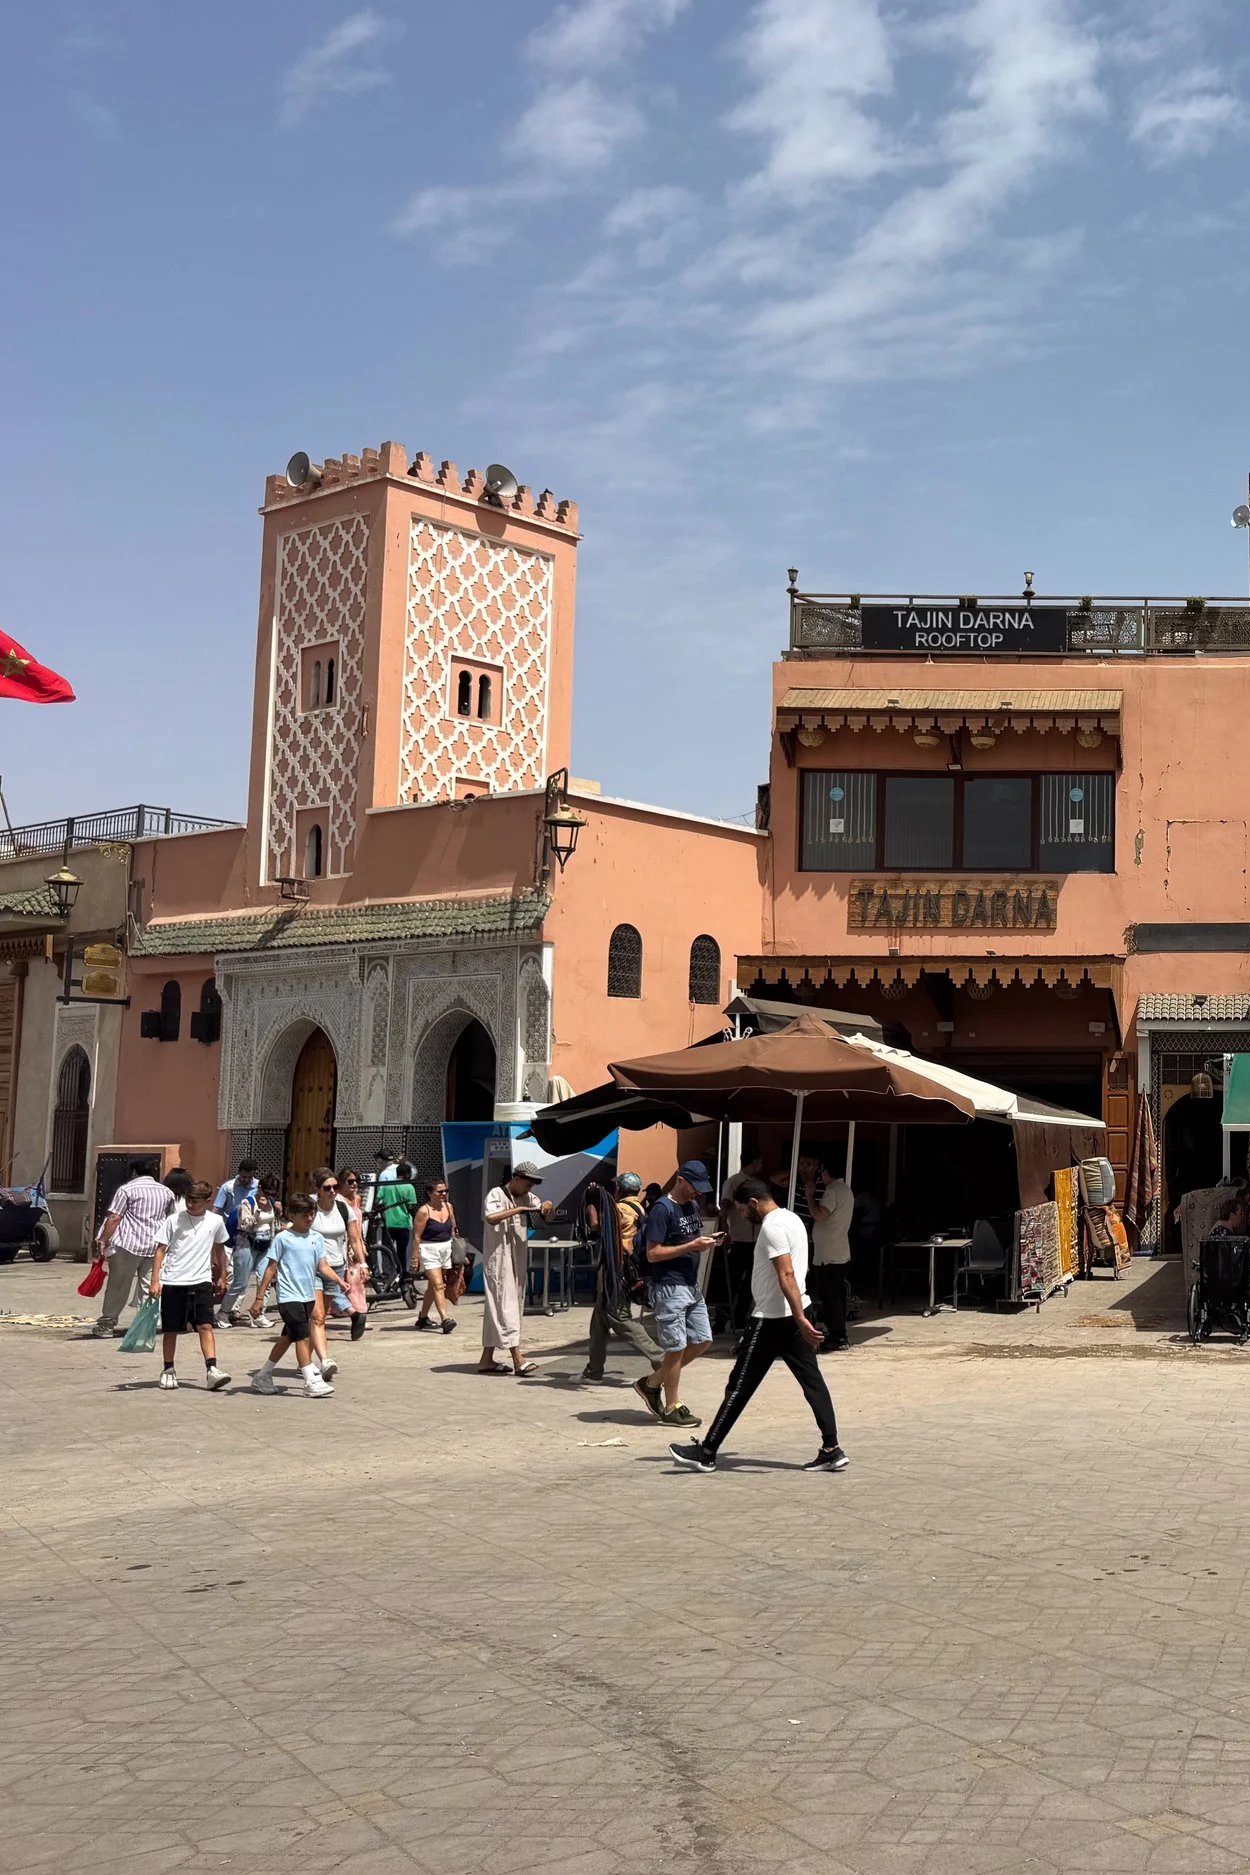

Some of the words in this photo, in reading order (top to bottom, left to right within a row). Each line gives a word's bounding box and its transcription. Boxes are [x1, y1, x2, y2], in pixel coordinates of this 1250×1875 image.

[893, 611, 952, 629] TAJIN
[959, 611, 1034, 630] DARNA
[915, 632, 1004, 648] ROOFTOP
[858, 889, 942, 925] TAJIN
[952, 889, 1051, 925] DARNA
